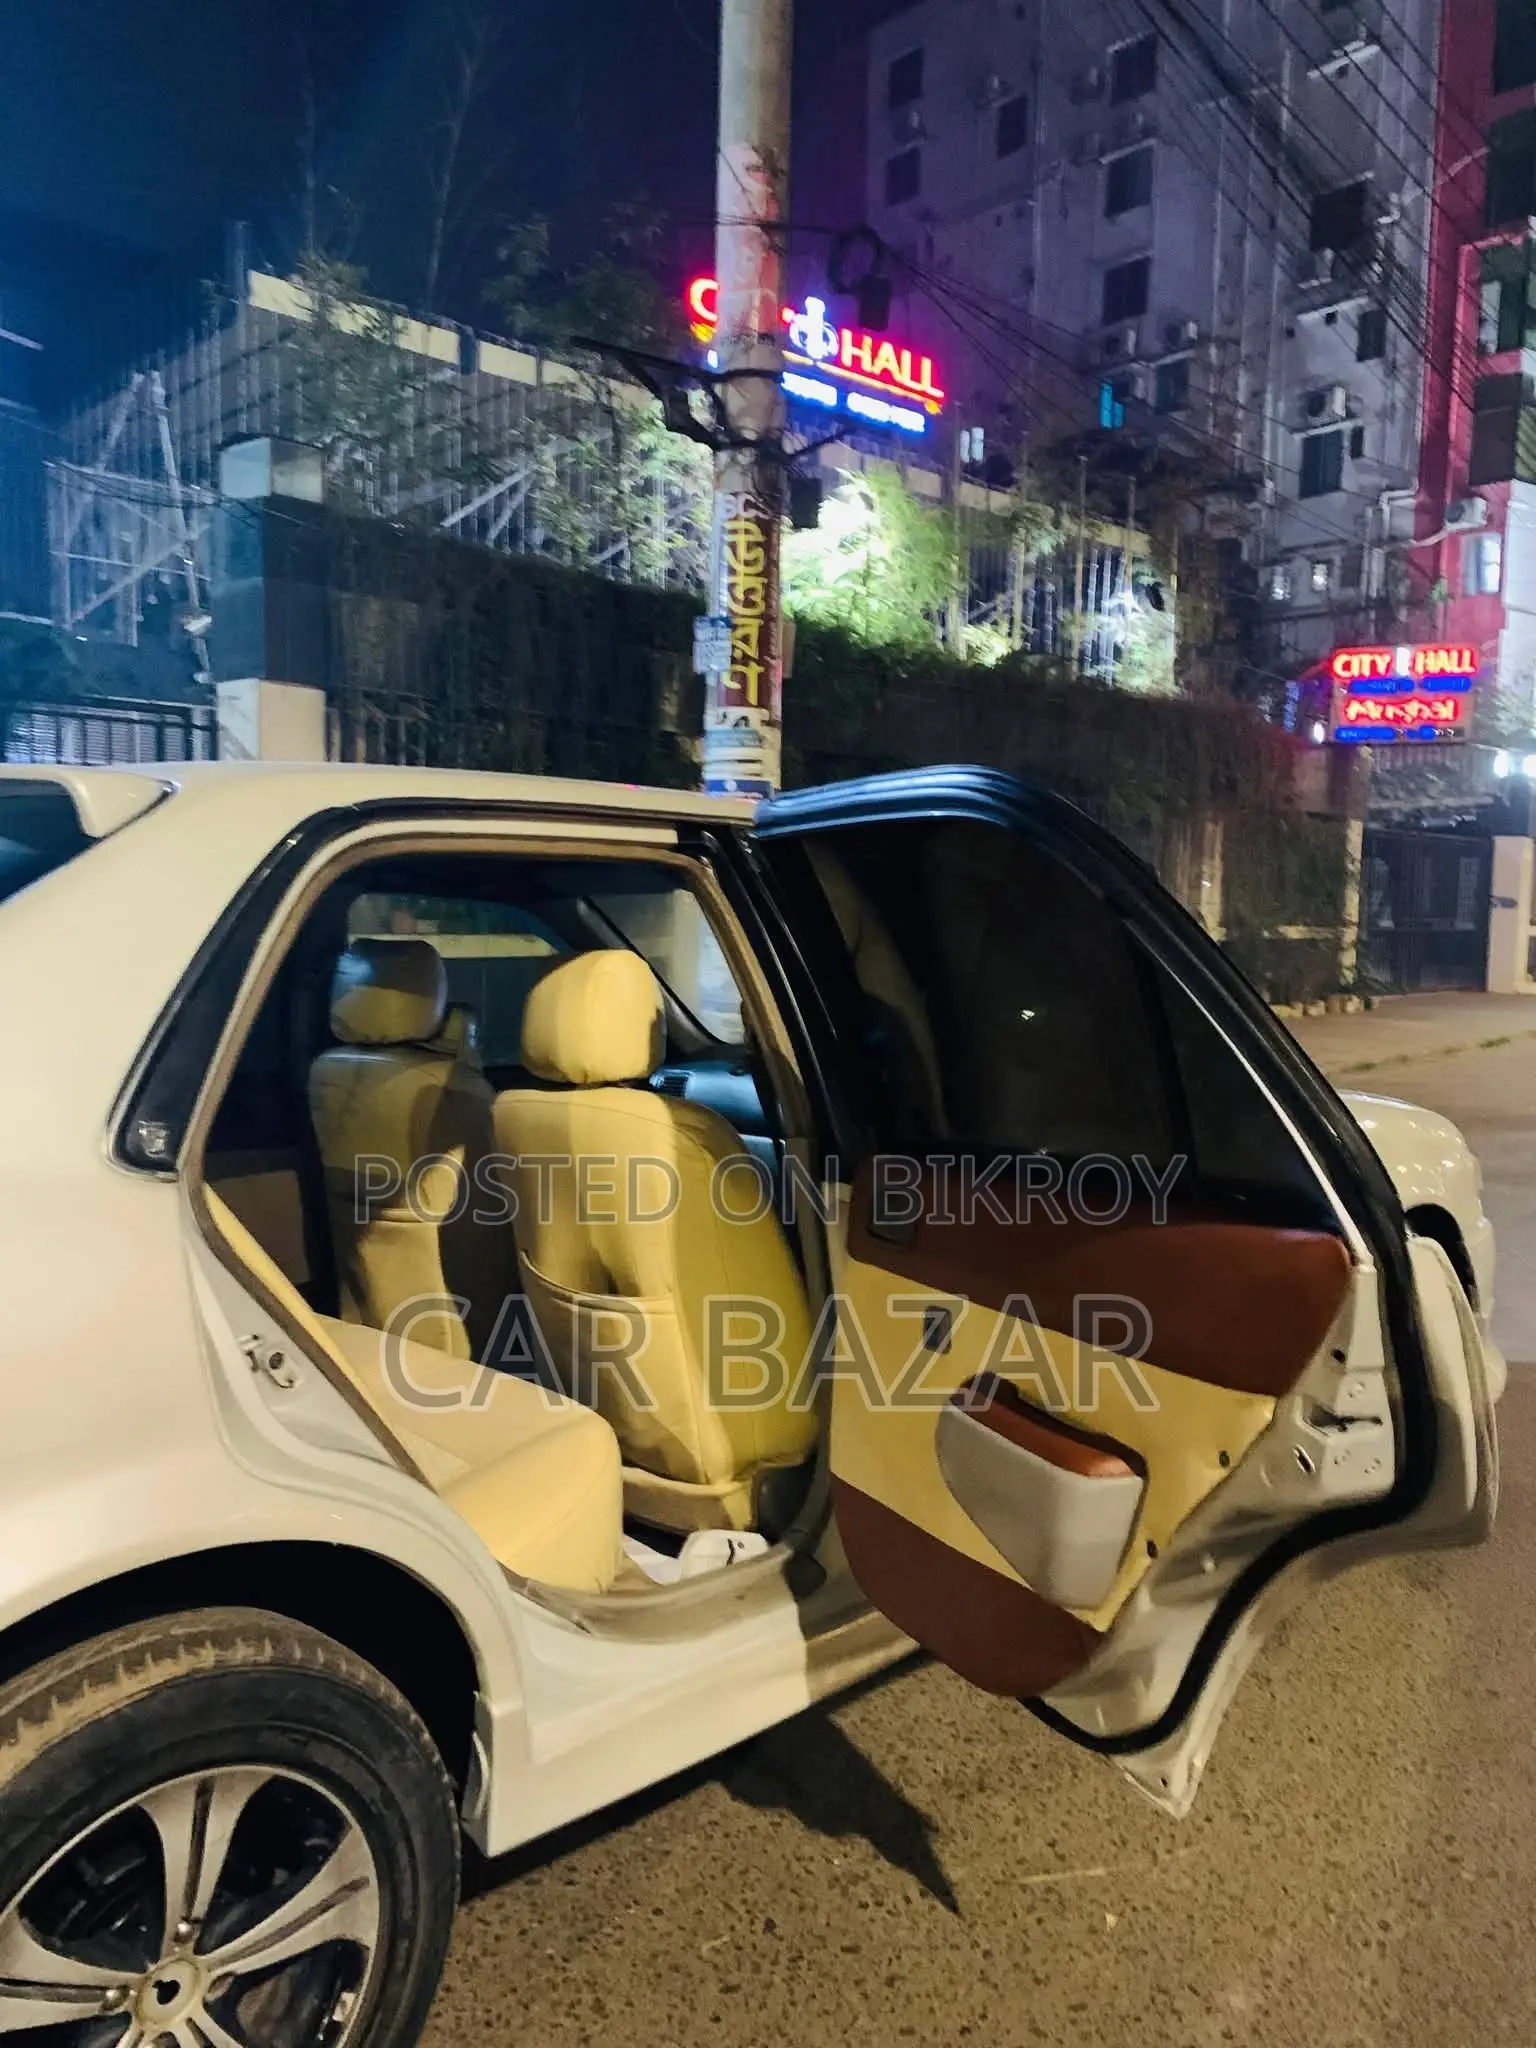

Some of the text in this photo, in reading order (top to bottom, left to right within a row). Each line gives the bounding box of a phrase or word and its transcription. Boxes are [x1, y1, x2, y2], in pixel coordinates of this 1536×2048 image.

[840, 328, 945, 398] HALL
[1332, 649, 1476, 677] CITY HALL
